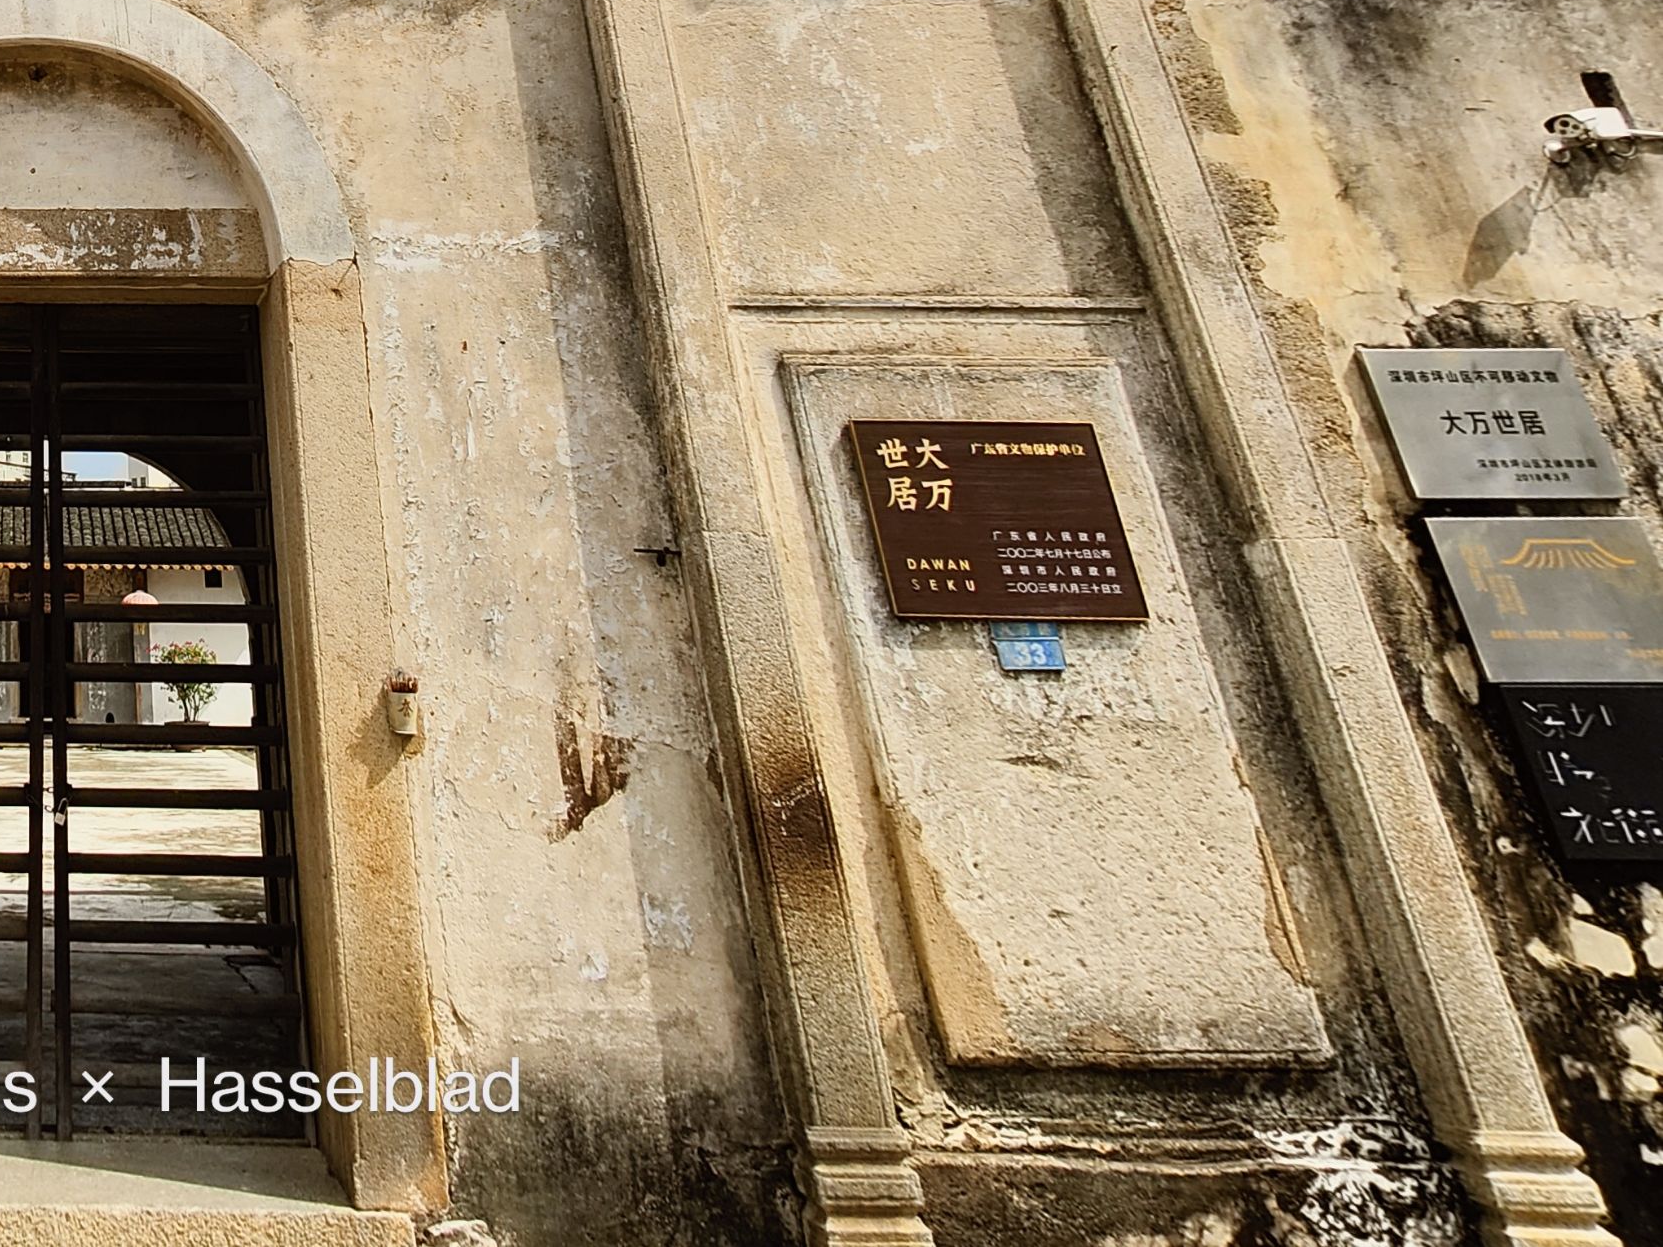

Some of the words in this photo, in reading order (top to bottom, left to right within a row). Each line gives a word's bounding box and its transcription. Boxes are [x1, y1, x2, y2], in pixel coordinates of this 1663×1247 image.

[1440, 410, 1546, 436] 大万世居
[970, 442, 1087, 456] 广东省文物保护单位
[992, 530, 1107, 543] 广东省人民政府
[906, 558, 971, 572] DAWAN
[1001, 564, 1117, 577] 深圳市人民政府
[911, 579, 976, 593] SEKU
[1014, 642, 1047, 666] 33
